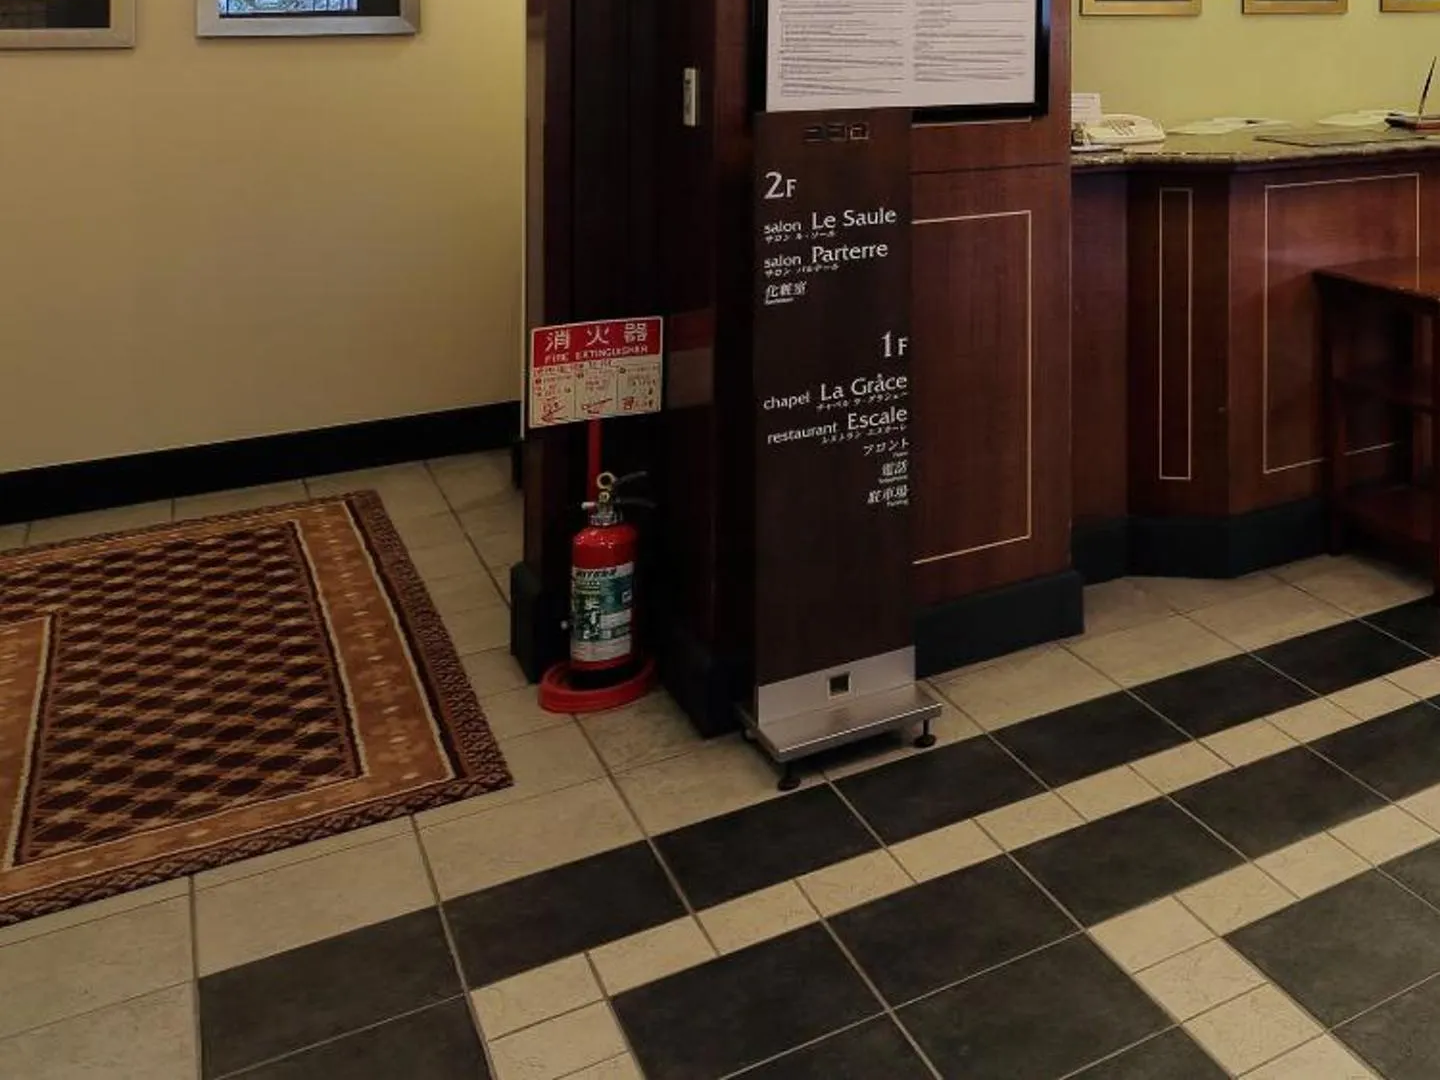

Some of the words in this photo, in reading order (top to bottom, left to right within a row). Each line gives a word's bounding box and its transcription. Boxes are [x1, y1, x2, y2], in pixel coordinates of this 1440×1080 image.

[764, 171, 798, 200] 2F
[763, 221, 802, 235] salon
[811, 211, 837, 231] Le
[843, 207, 897, 228] Saule
[763, 253, 802, 269] salon
[811, 243, 889, 264] Parterre
[545, 322, 648, 352] 消火器
[881, 330, 909, 357] 1F
[763, 391, 810, 411] chapel
[820, 383, 844, 402] La
[767, 421, 838, 445] restaurant
[847, 406, 908, 431] Escale
